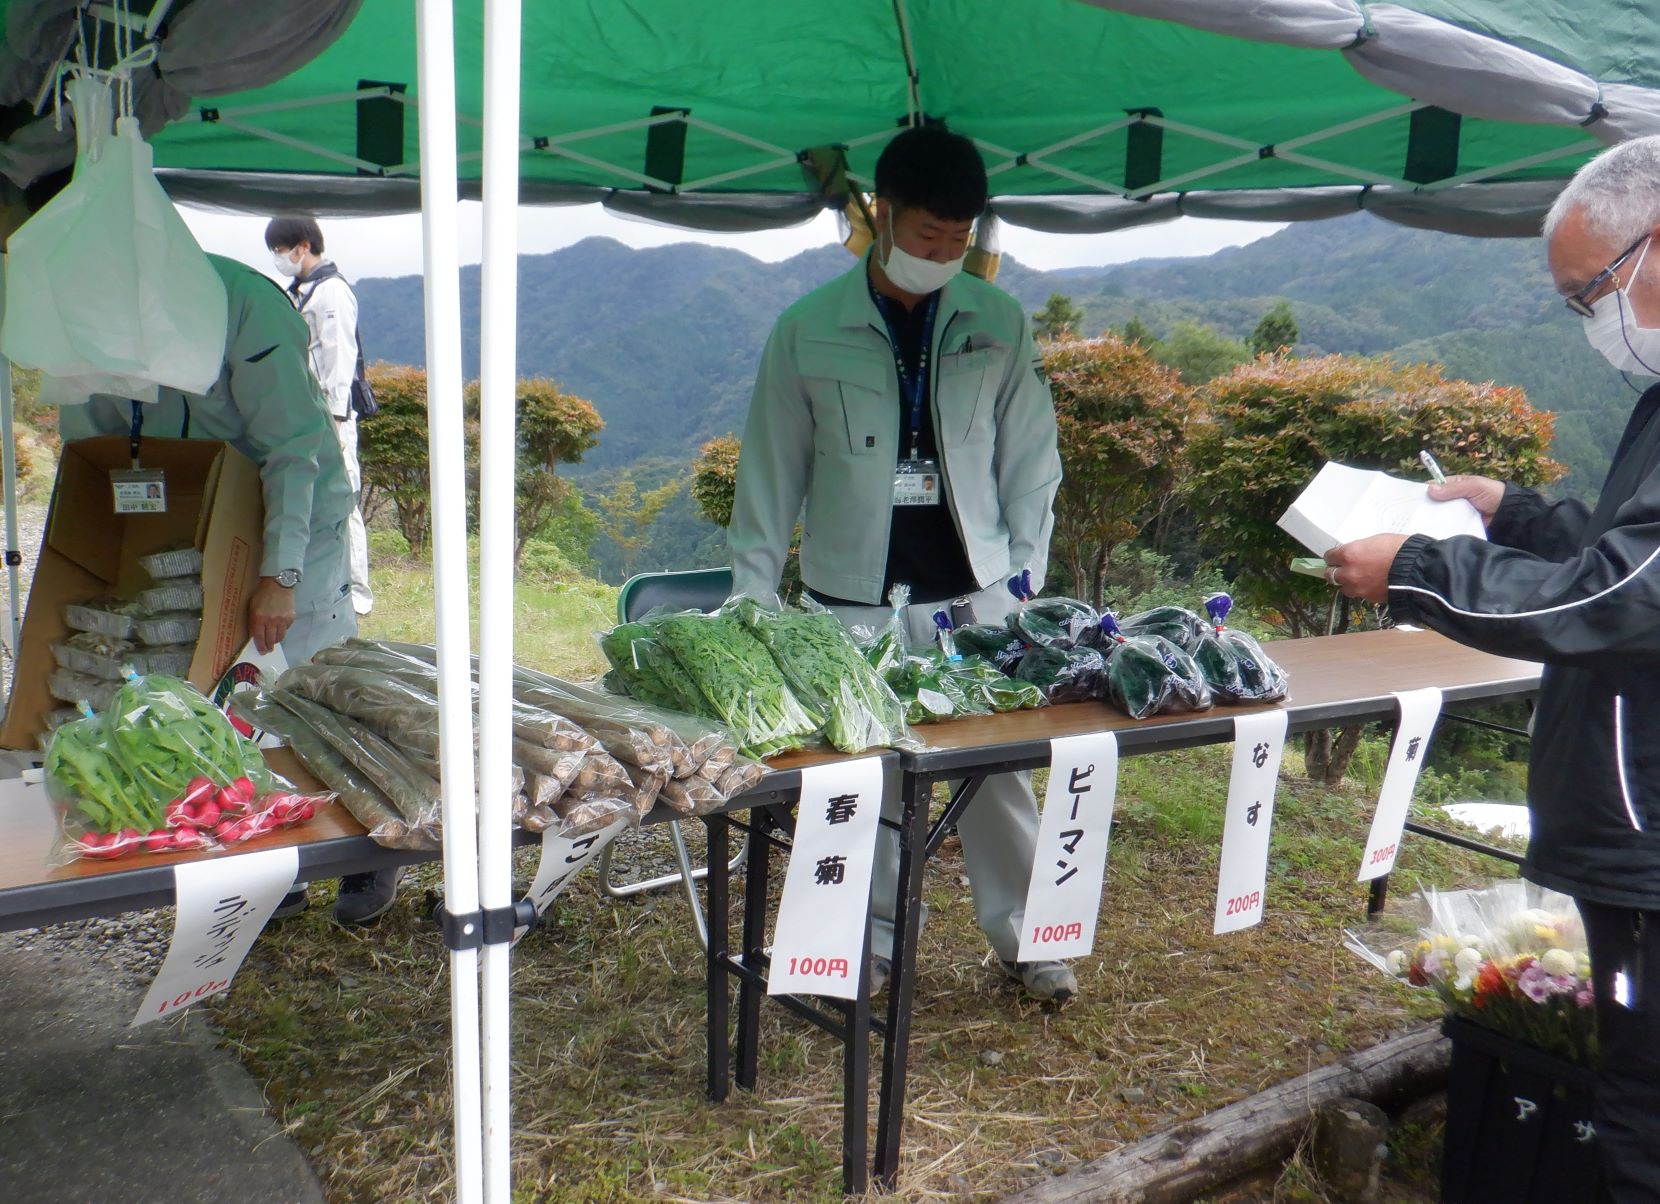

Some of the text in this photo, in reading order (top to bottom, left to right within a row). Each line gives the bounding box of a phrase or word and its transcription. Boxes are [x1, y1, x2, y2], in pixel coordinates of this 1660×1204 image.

[1246, 742, 1270, 827] なす
[1055, 763, 1095, 887] ピーマン
[814, 793, 860, 885] 春菊
[1370, 843, 1396, 865] 300円
[1226, 891, 1260, 916] 200円
[1032, 922, 1082, 944] 100円
[788, 957, 849, 978] 100円
